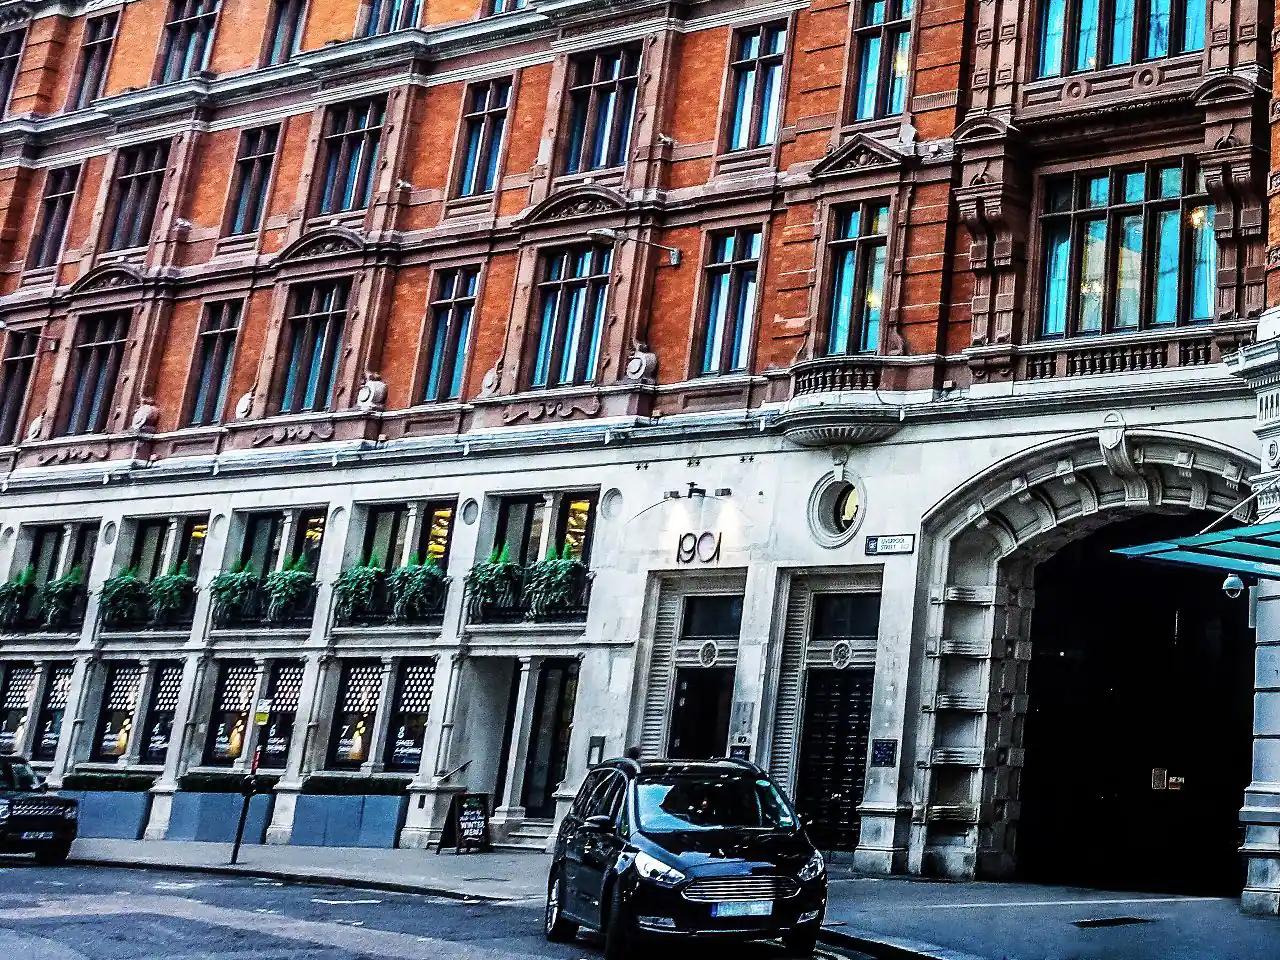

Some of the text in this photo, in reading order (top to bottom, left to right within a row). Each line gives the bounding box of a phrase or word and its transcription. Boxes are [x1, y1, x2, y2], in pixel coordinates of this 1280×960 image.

[676, 531, 722, 564] 1901
[104, 722, 112, 733] 3
[152, 722, 161, 735] 4
[217, 723, 226, 735] 5
[269, 723, 277, 737] 6
[340, 724, 351, 738] 7
[397, 725, 406, 739] 8
